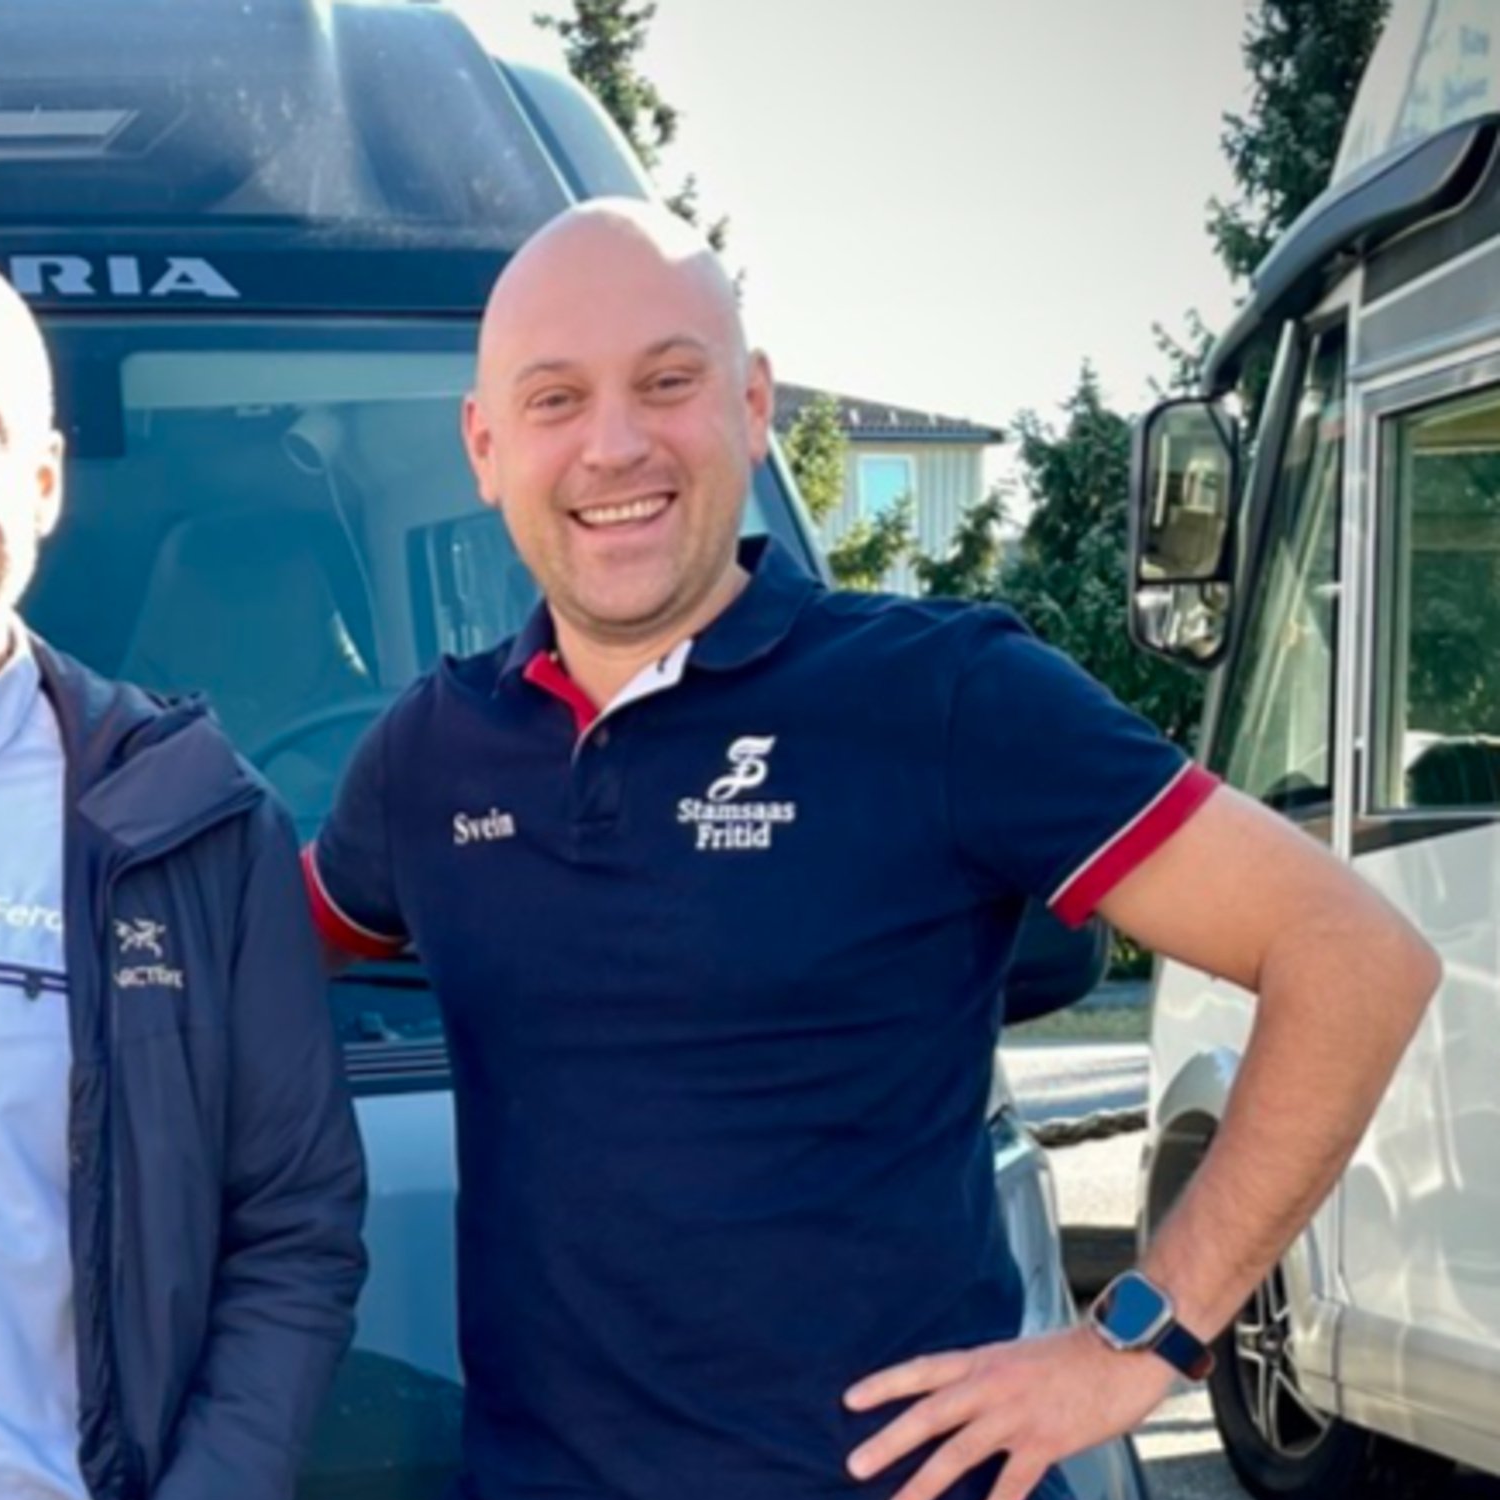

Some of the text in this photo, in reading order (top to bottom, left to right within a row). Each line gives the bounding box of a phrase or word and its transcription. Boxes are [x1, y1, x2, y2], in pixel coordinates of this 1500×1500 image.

[676, 798, 796, 824] Stamsaas
[453, 808, 516, 845] Svein
[696, 823, 771, 850] Fritid
